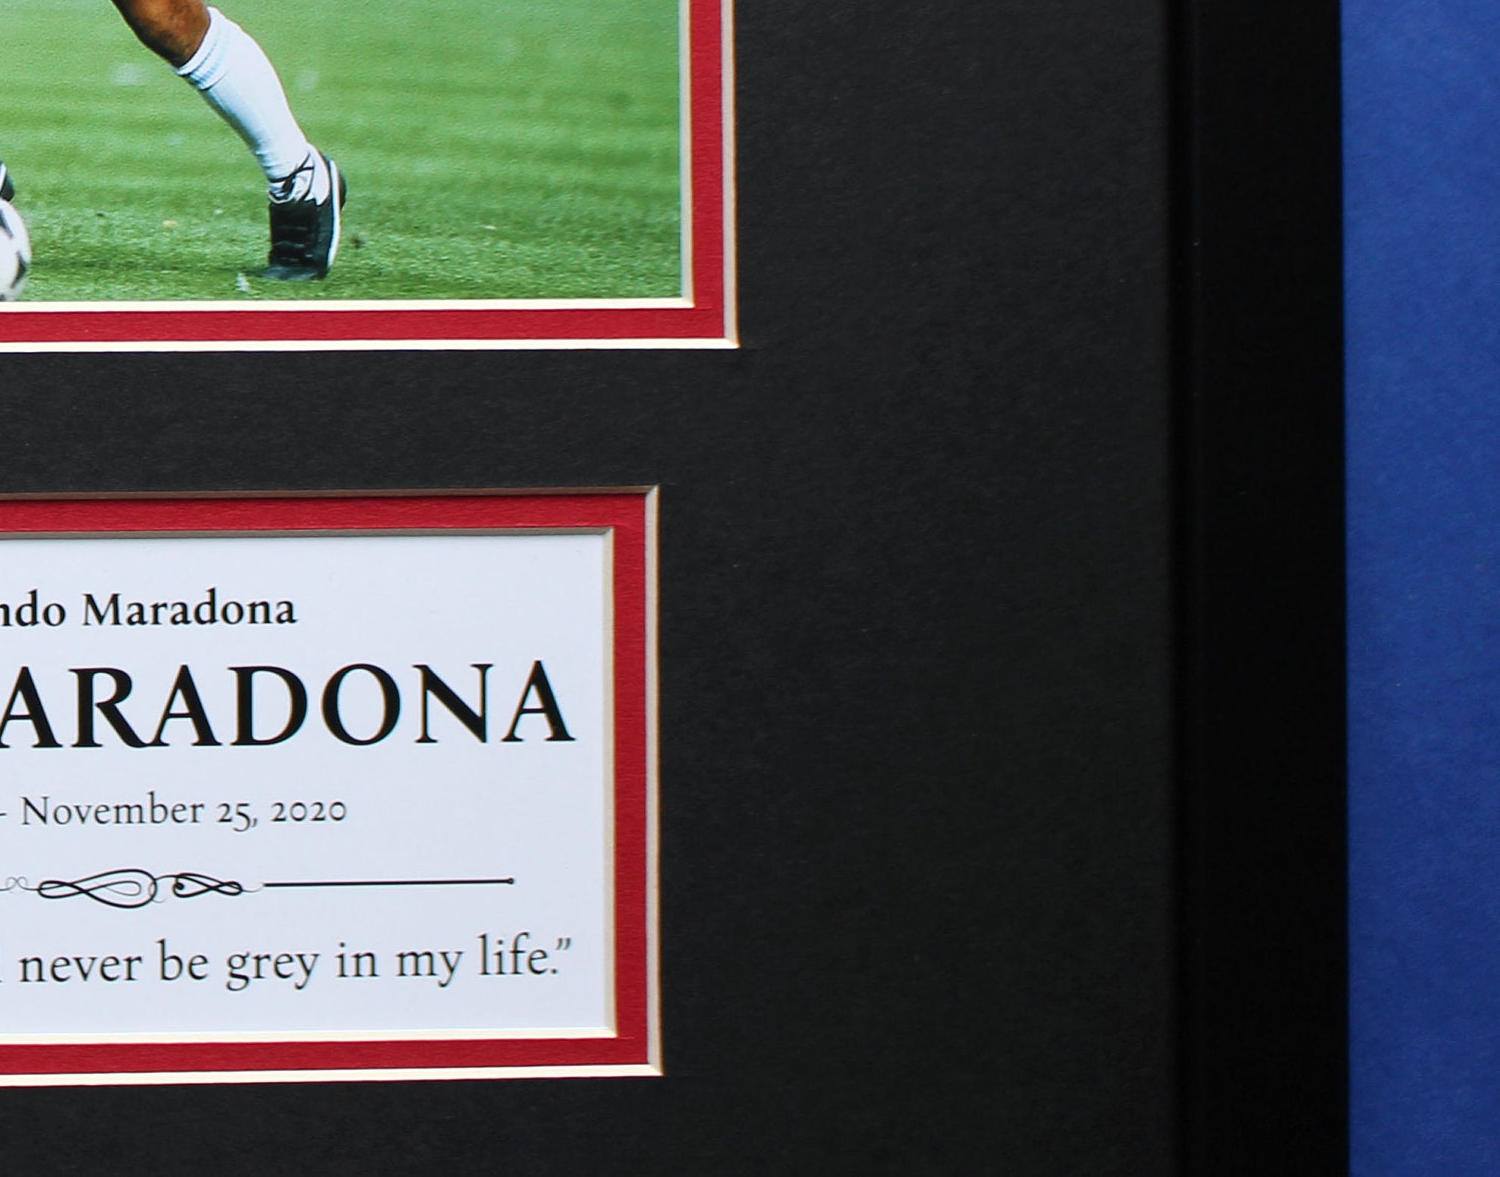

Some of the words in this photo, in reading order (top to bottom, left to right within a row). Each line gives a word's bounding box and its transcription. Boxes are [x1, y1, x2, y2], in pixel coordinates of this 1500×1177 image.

[83, 587, 297, 627] Maradona
[21, 790, 205, 826] November
[217, 802, 258, 833] 25,
[271, 801, 346, 823] 2020
[18, 955, 143, 983] never
[156, 938, 209, 982] be
[225, 951, 321, 992] grey
[335, 941, 380, 978] in
[396, 950, 464, 989] my
[477, 931, 572, 976] life.”
